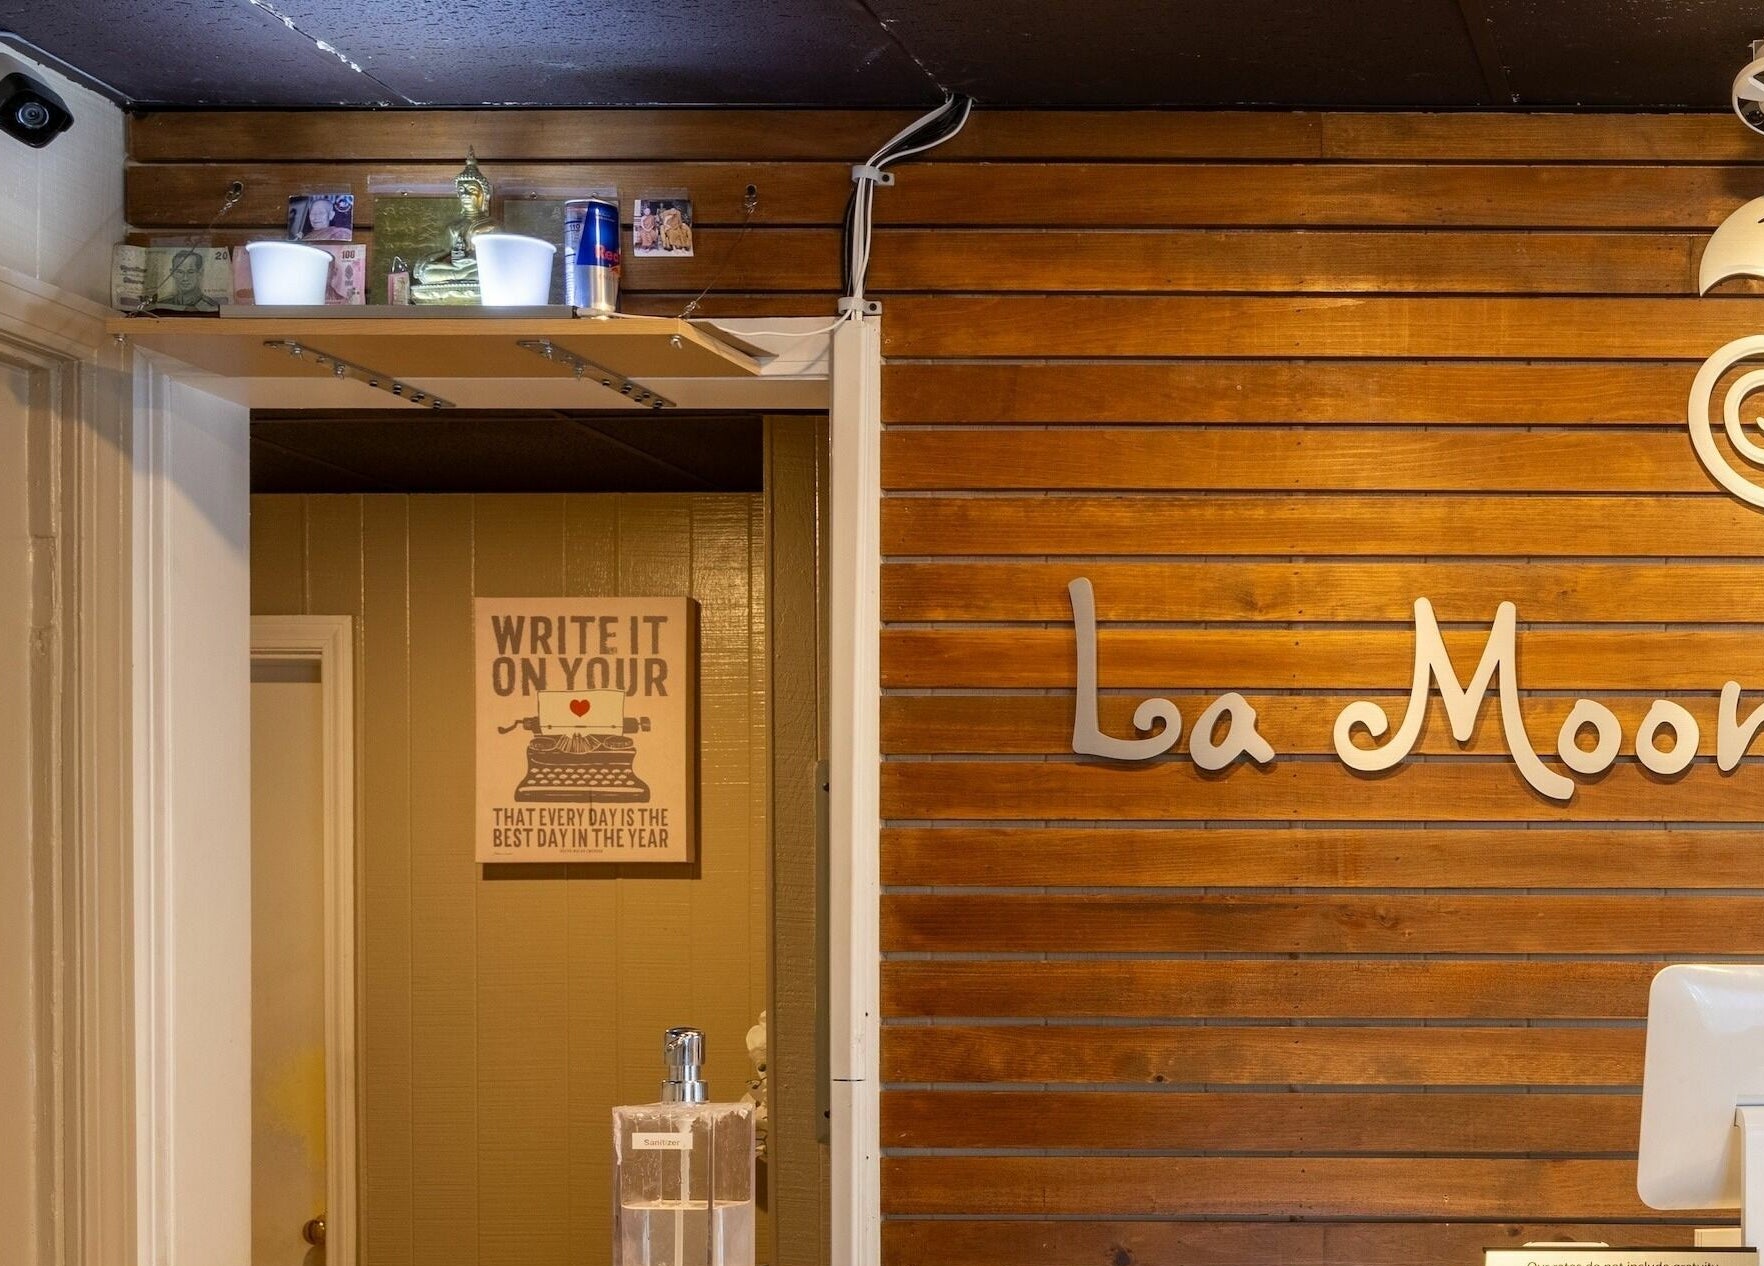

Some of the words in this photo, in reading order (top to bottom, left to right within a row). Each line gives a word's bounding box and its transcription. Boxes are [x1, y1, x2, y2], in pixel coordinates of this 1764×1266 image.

[215, 251, 228, 261] 20
[491, 615, 619, 655] WRITE
[630, 615, 668, 655] IT
[492, 657, 547, 697] ON
[559, 657, 668, 697] YOUR
[1067, 576, 1275, 772] La
[493, 808, 536, 827] THAT
[540, 808, 584, 827] EVERY
[589, 808, 617, 827] DAY
[621, 808, 634, 827] IS
[638, 808, 668, 827] THE
[493, 828, 533, 848] BEST
[538, 828, 568, 848] DAY
[572, 828, 588, 848] IN
[592, 828, 624, 848] THE
[629, 828, 668, 848] YEAR
